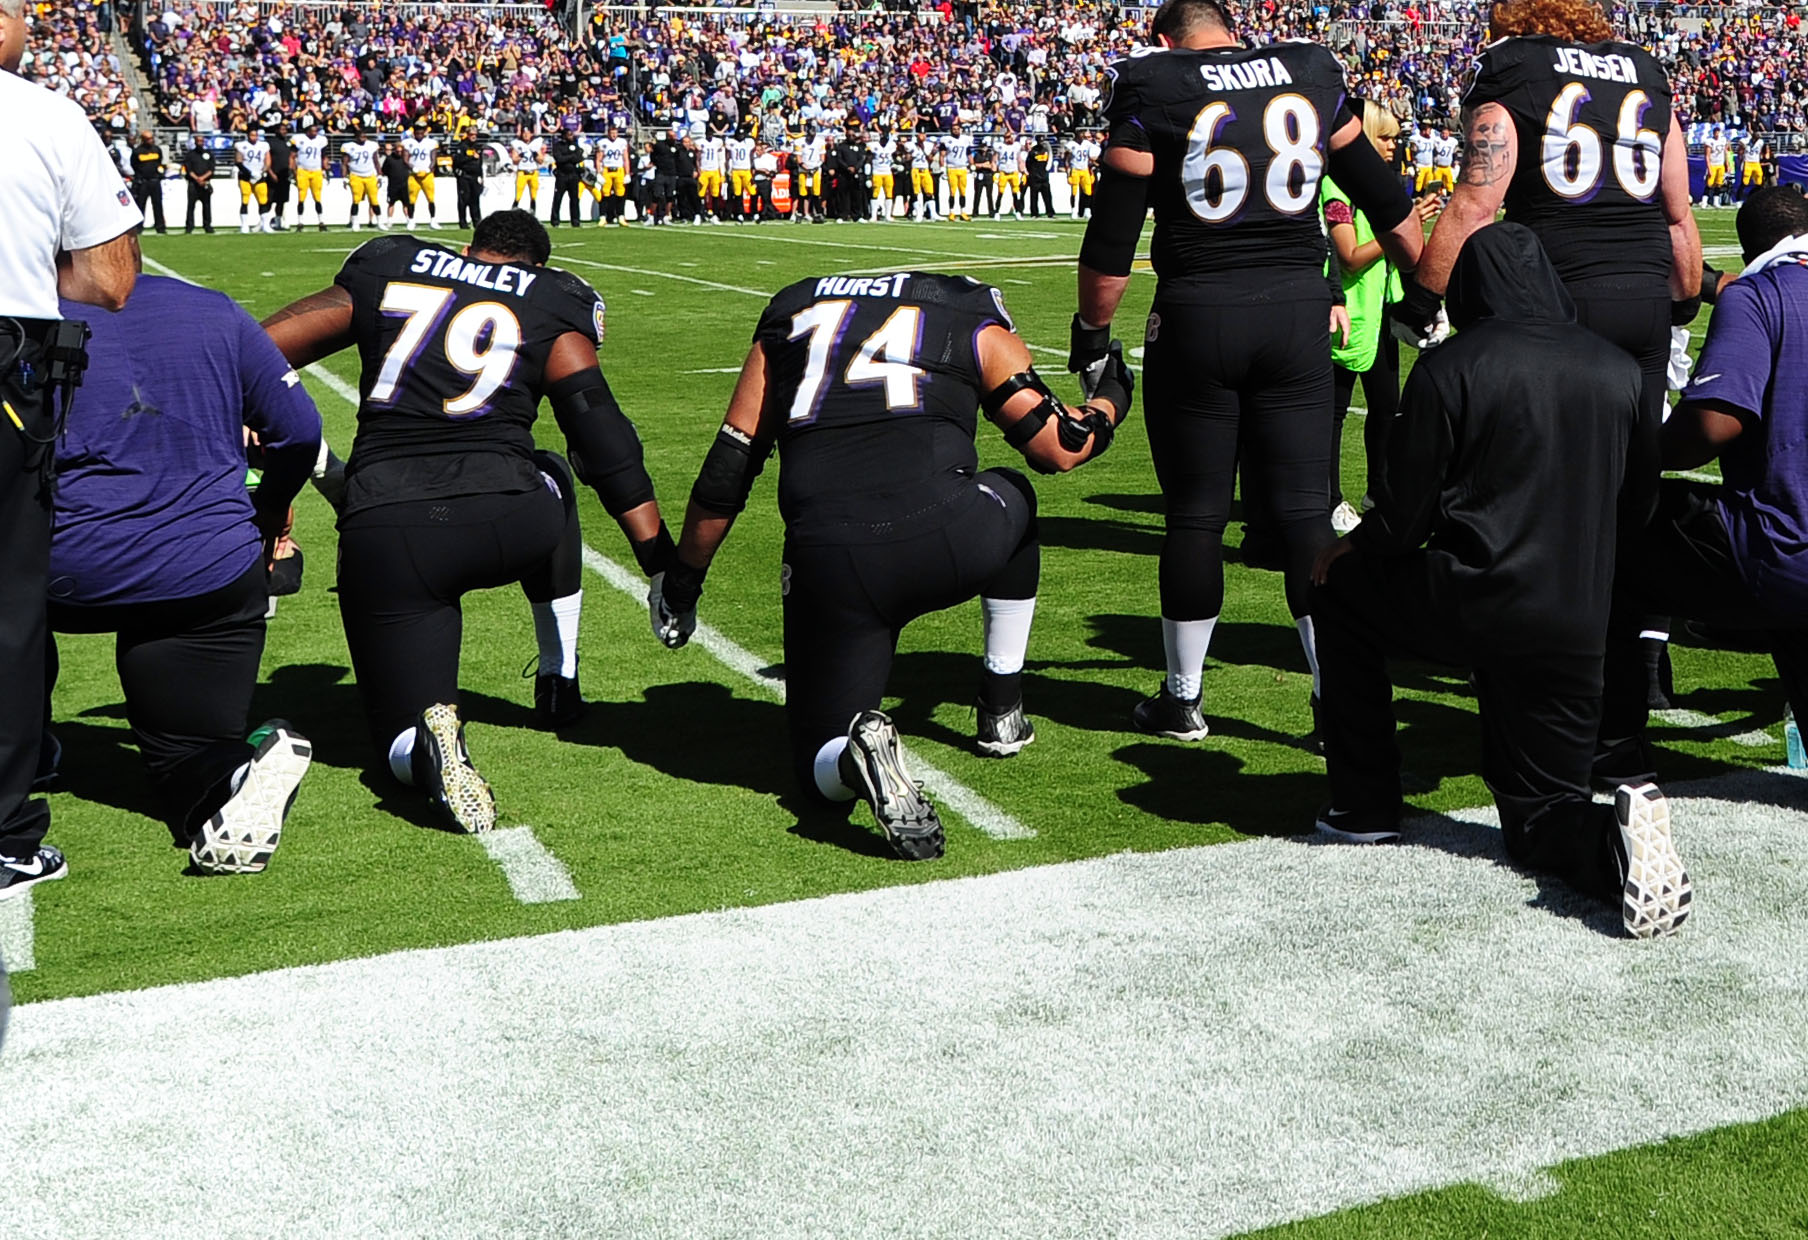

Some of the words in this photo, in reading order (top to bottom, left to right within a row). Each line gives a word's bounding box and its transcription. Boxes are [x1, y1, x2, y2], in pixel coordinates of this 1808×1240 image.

[1552, 47, 1638, 84] JENSEN
[1200, 57, 1292, 91] SKURA
[1540, 81, 1662, 200] 66
[247, 149, 263, 162] 94
[305, 146, 318, 159] 91
[412, 148, 427, 161] 96
[607, 149, 621, 160] 90
[735, 148, 746, 161] 10
[808, 148, 816, 161] 7
[952, 146, 965, 159] 97
[1181, 93, 1324, 223] 68
[1440, 146, 1452, 157] 67
[411, 249, 536, 296] STANLEY
[814, 273, 911, 299] HURST
[367, 282, 523, 416] 79
